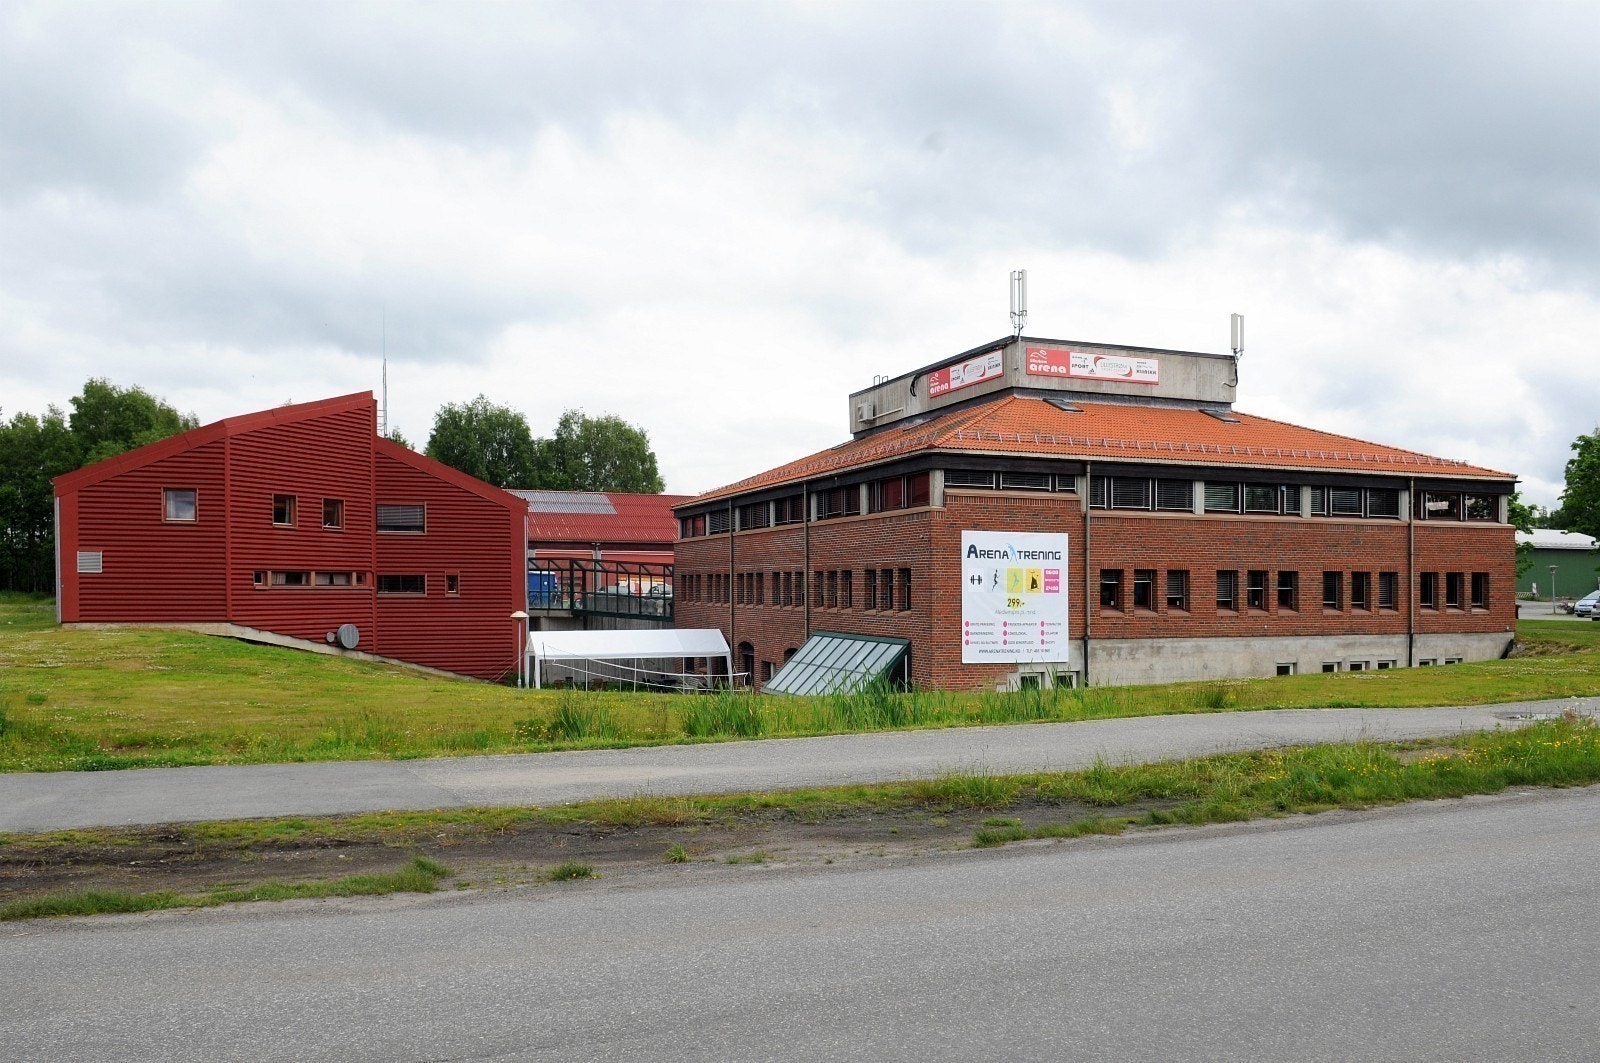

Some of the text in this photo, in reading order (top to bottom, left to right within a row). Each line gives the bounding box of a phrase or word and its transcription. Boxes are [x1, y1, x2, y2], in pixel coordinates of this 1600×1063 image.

[1029, 363, 1067, 374] arena
[929, 382, 949, 394] arena
[967, 544, 1061, 560] ARENA TRENING
